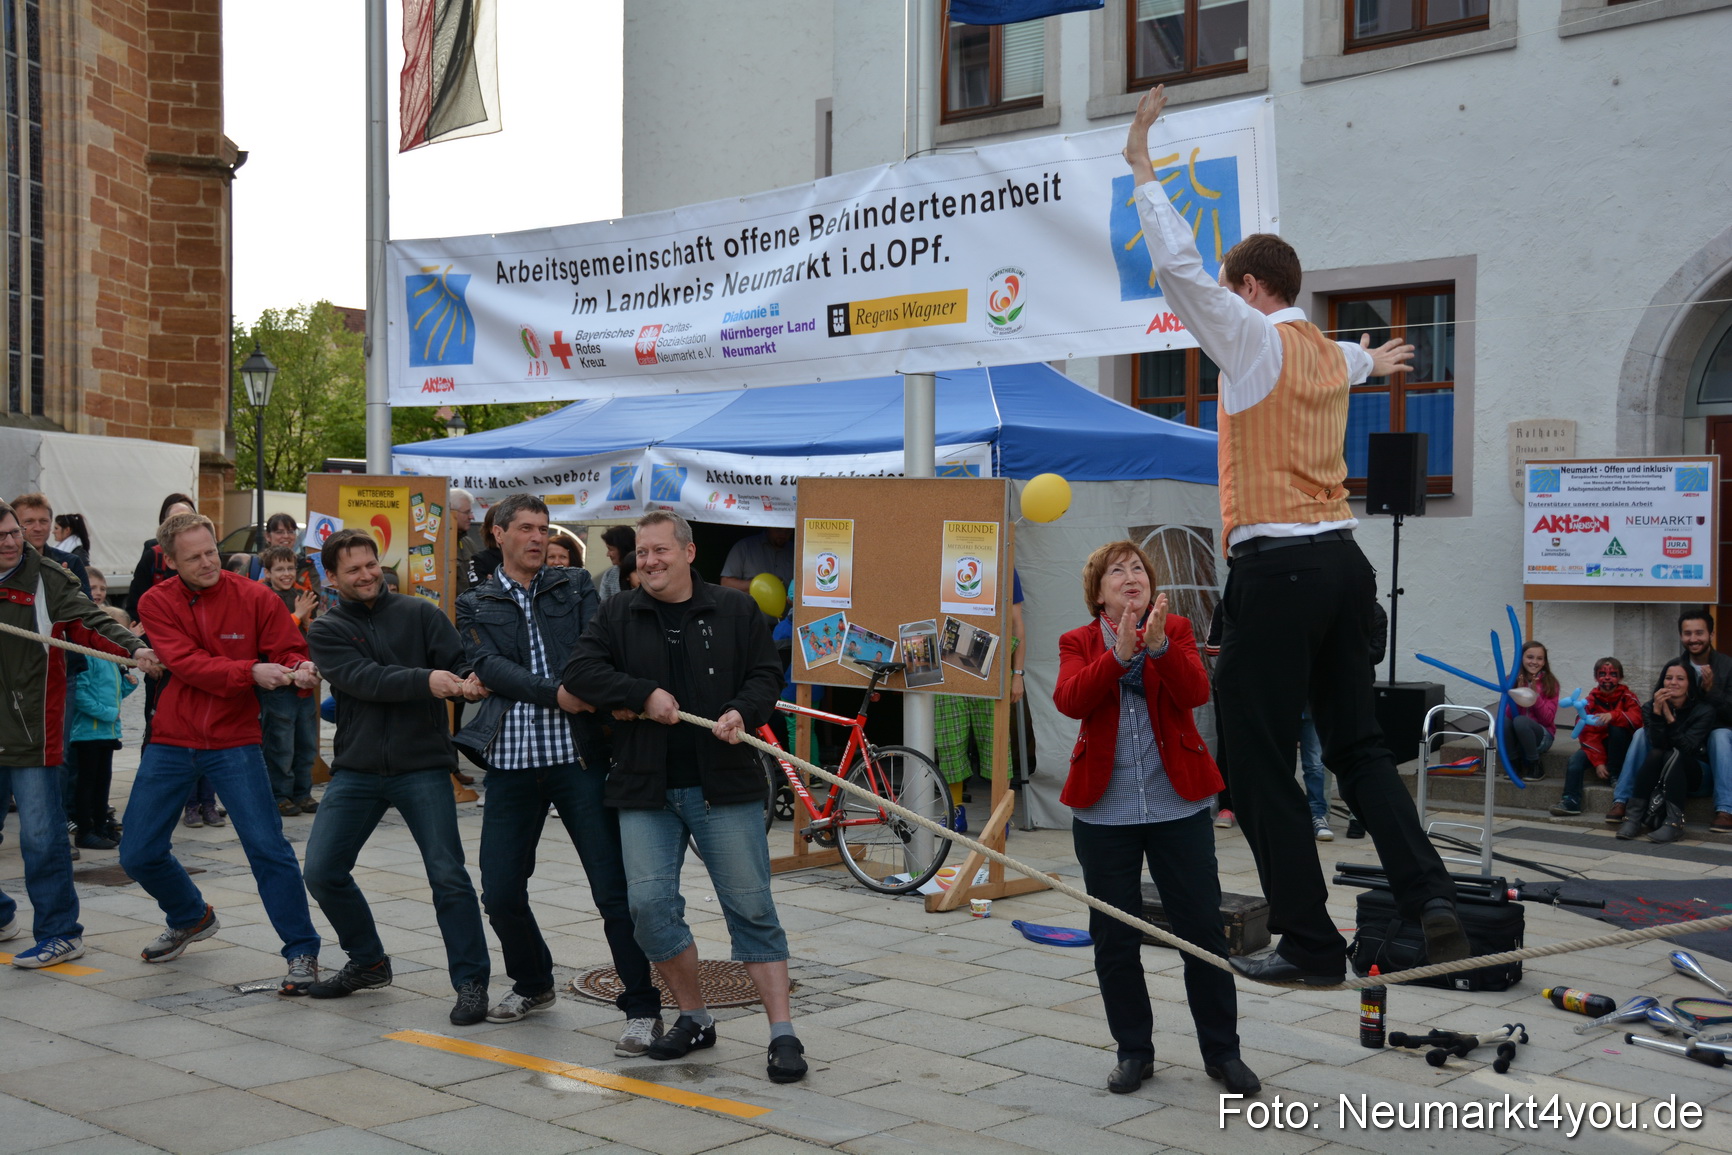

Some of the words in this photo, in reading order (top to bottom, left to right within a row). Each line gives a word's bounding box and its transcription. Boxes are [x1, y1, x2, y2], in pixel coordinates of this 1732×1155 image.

[496, 236, 715, 285] Arbeitsgemeinschaft
[724, 226, 800, 258] offene
[808, 172, 1062, 241] Behindertenarbeit
[571, 292, 597, 315] im
[606, 277, 714, 313] Landkreis
[721, 251, 831, 298] Neumarkt
[842, 235, 950, 275] i.d.OPf.
[989, 267, 1026, 282] SYMPATHIEBLUME
[722, 306, 767, 324] Diakonie
[856, 304, 899, 328] Regens
[902, 300, 957, 322] Wagner
[575, 328, 635, 343] Bayerisches
[661, 323, 693, 334] Caritas-
[720, 325, 783, 341] Nürnberger
[787, 318, 816, 334] Land
[656, 332, 707, 348] Sozialstation
[575, 343, 601, 355] Rotes
[657, 350, 697, 363] Neumarkt
[698, 347, 715, 360] e.V.
[722, 341, 777, 358] Neumarkt
[580, 357, 606, 369] Kreuz
[1560, 466, 1598, 474] Neumarkt
[1604, 465, 1625, 473] Offen
[1626, 465, 1641, 473] und
[1643, 464, 1673, 473] inklusiv
[464, 475, 528, 489] Mit-Mach
[533, 469, 600, 486] Angebote
[706, 470, 773, 486] Aktionen
[357, 489, 394, 498] WETTBEWERB
[348, 499, 400, 509] SYMPATHIEBLUME
[809, 521, 850, 531] URKUNDE
[1626, 515, 1693, 525] NEUMARKT
[948, 524, 994, 534] URKUNDE
